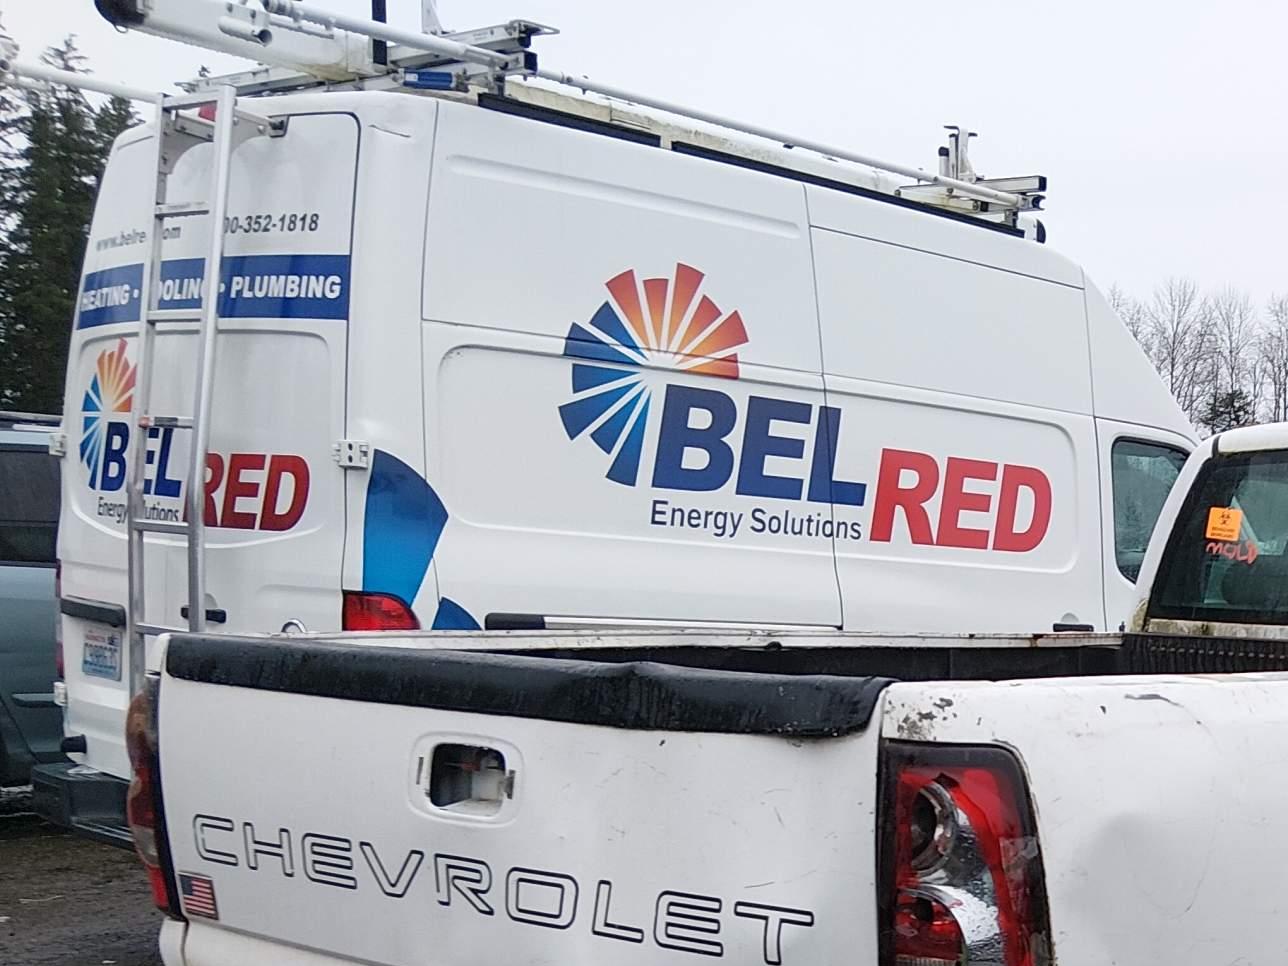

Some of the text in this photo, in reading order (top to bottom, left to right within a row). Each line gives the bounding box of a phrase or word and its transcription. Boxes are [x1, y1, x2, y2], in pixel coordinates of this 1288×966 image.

[224, 213, 320, 234] 00-352-1818
[159, 278, 205, 300] OLIN
[230, 275, 342, 299] PLUMBING
[651, 383, 1053, 553] BEL RED
[143, 501, 179, 523] utions
[650, 499, 862, 541] Energy Solutions
[1205, 541, 1259, 565] MOLD
[192, 813, 815, 966] CHEVROLET
